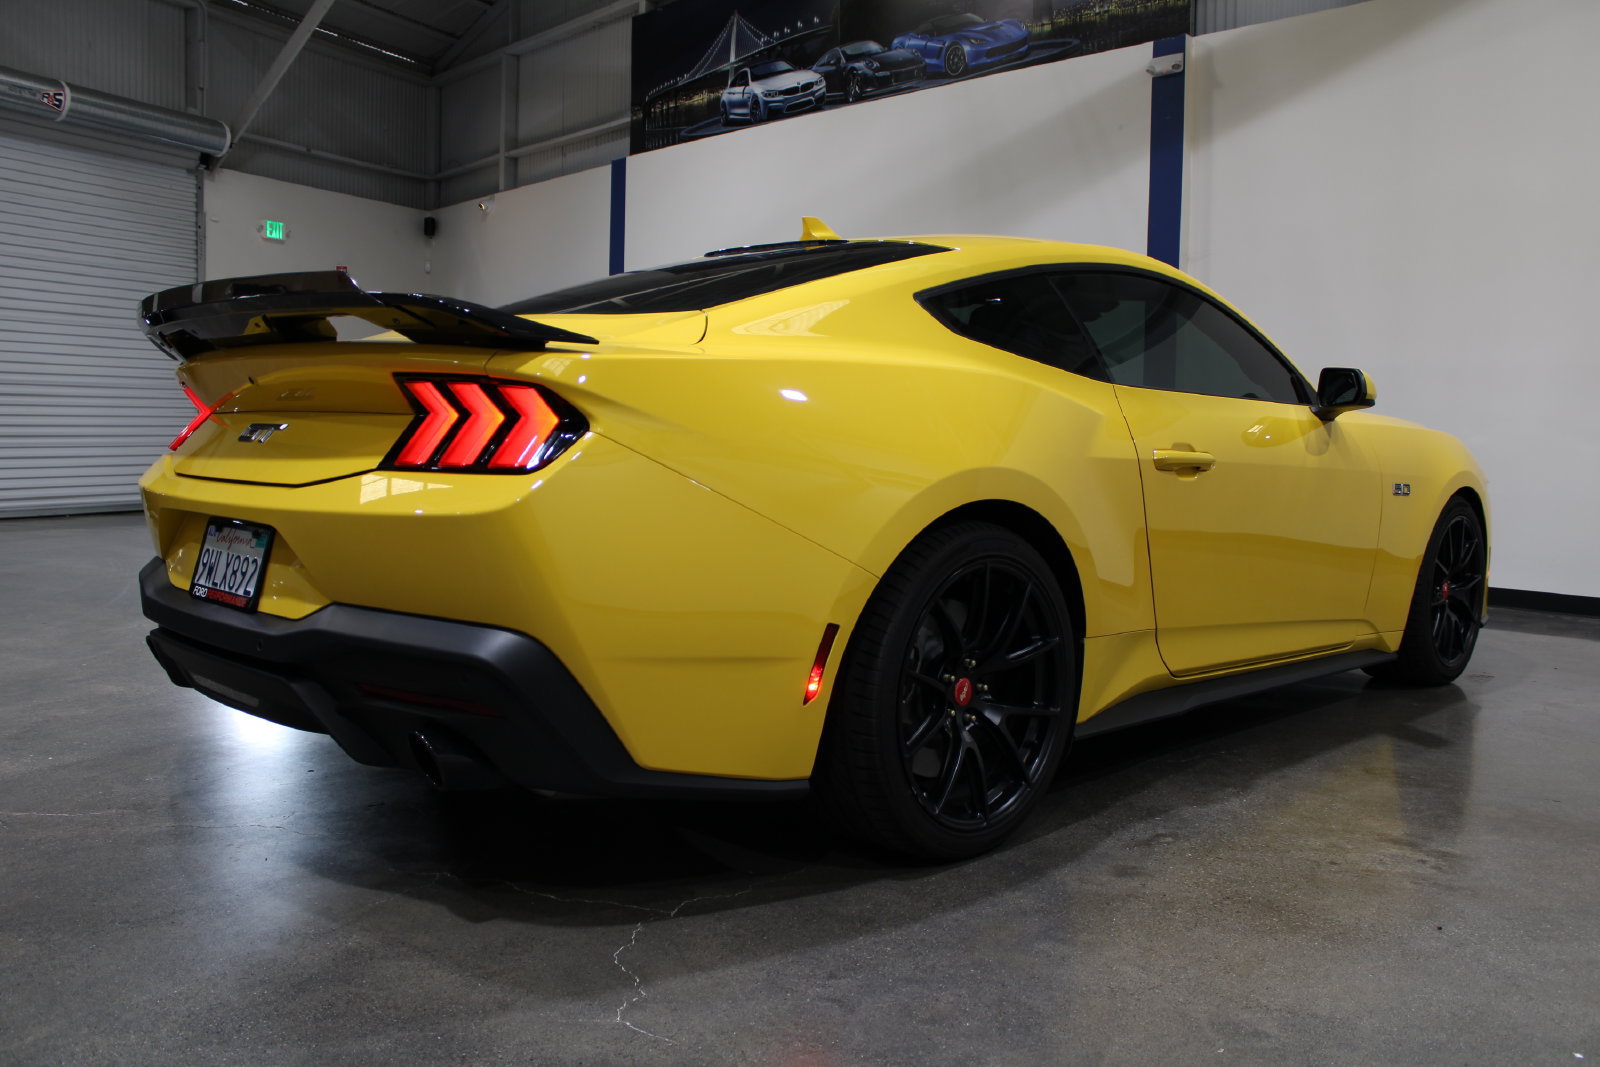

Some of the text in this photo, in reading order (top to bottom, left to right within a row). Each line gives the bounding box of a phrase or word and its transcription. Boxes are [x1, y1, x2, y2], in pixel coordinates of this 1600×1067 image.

[266, 220, 284, 240] EXIT
[238, 423, 289, 443] GT
[216, 528, 253, 550] California
[196, 548, 259, 597] 9WLX892
[193, 586, 208, 598] FORD
